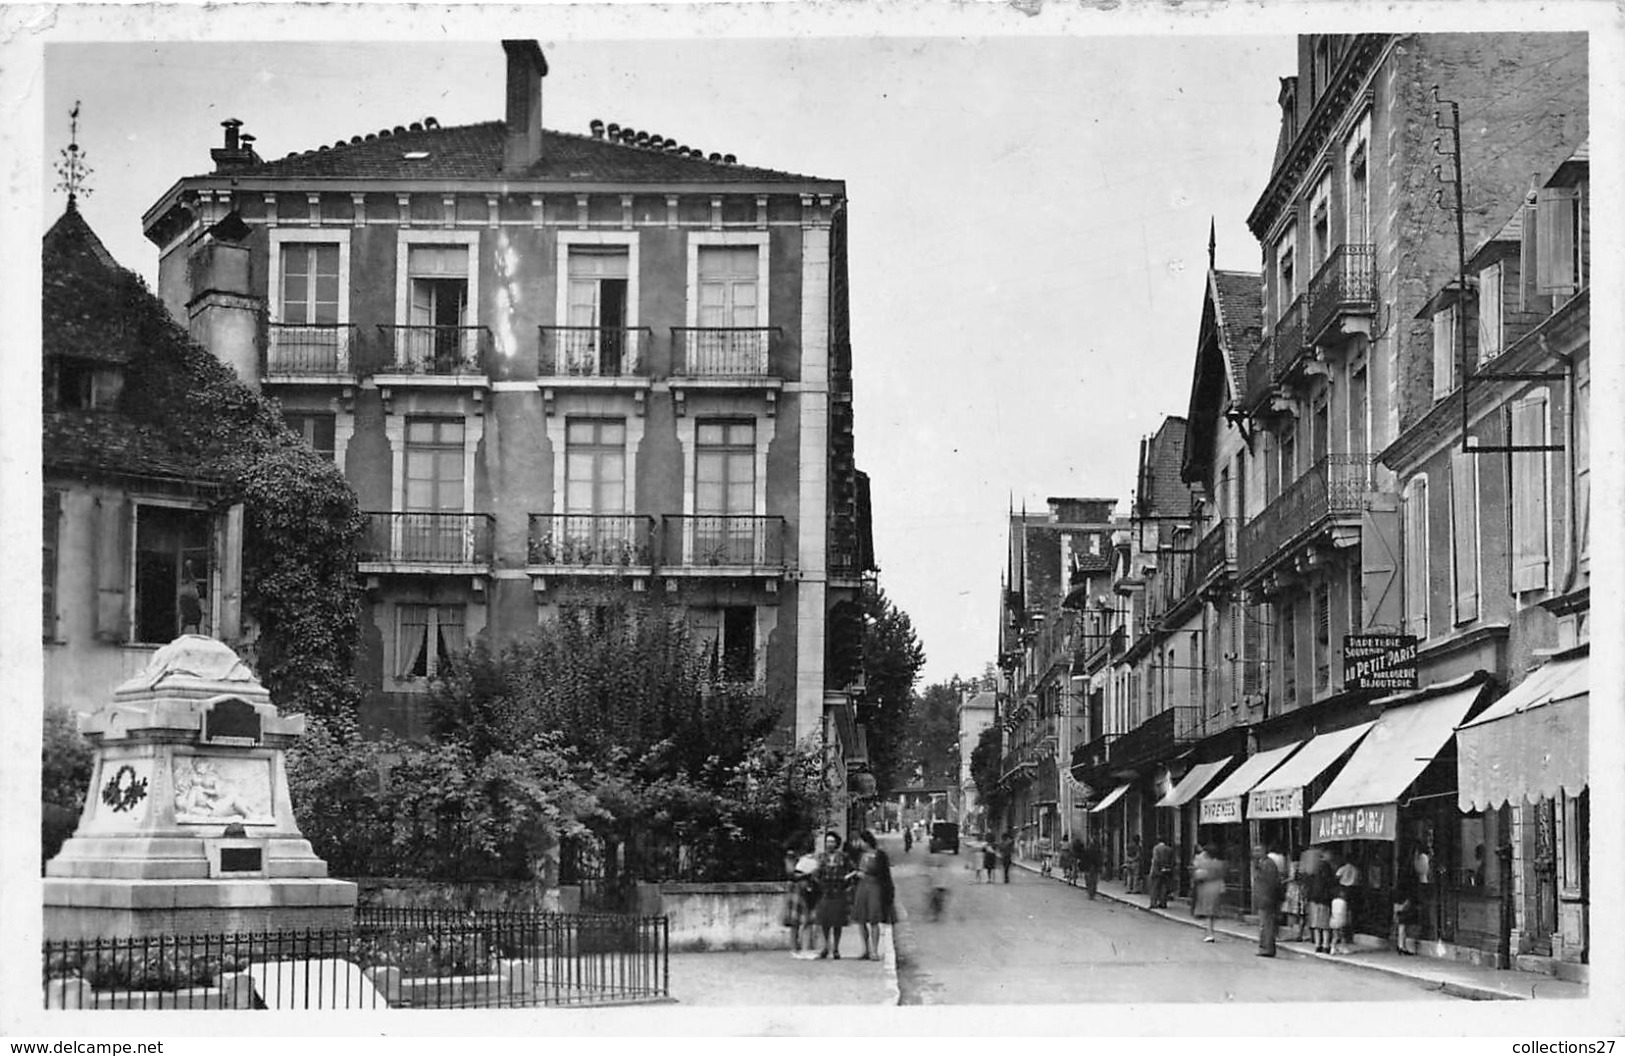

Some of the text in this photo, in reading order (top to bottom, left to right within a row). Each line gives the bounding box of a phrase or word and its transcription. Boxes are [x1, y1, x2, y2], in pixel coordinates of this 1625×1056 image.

[1356, 655, 1385, 678] PETIT
[1387, 645, 1416, 667] PARIS
[1360, 678, 1412, 688] BIJOUTERIE
